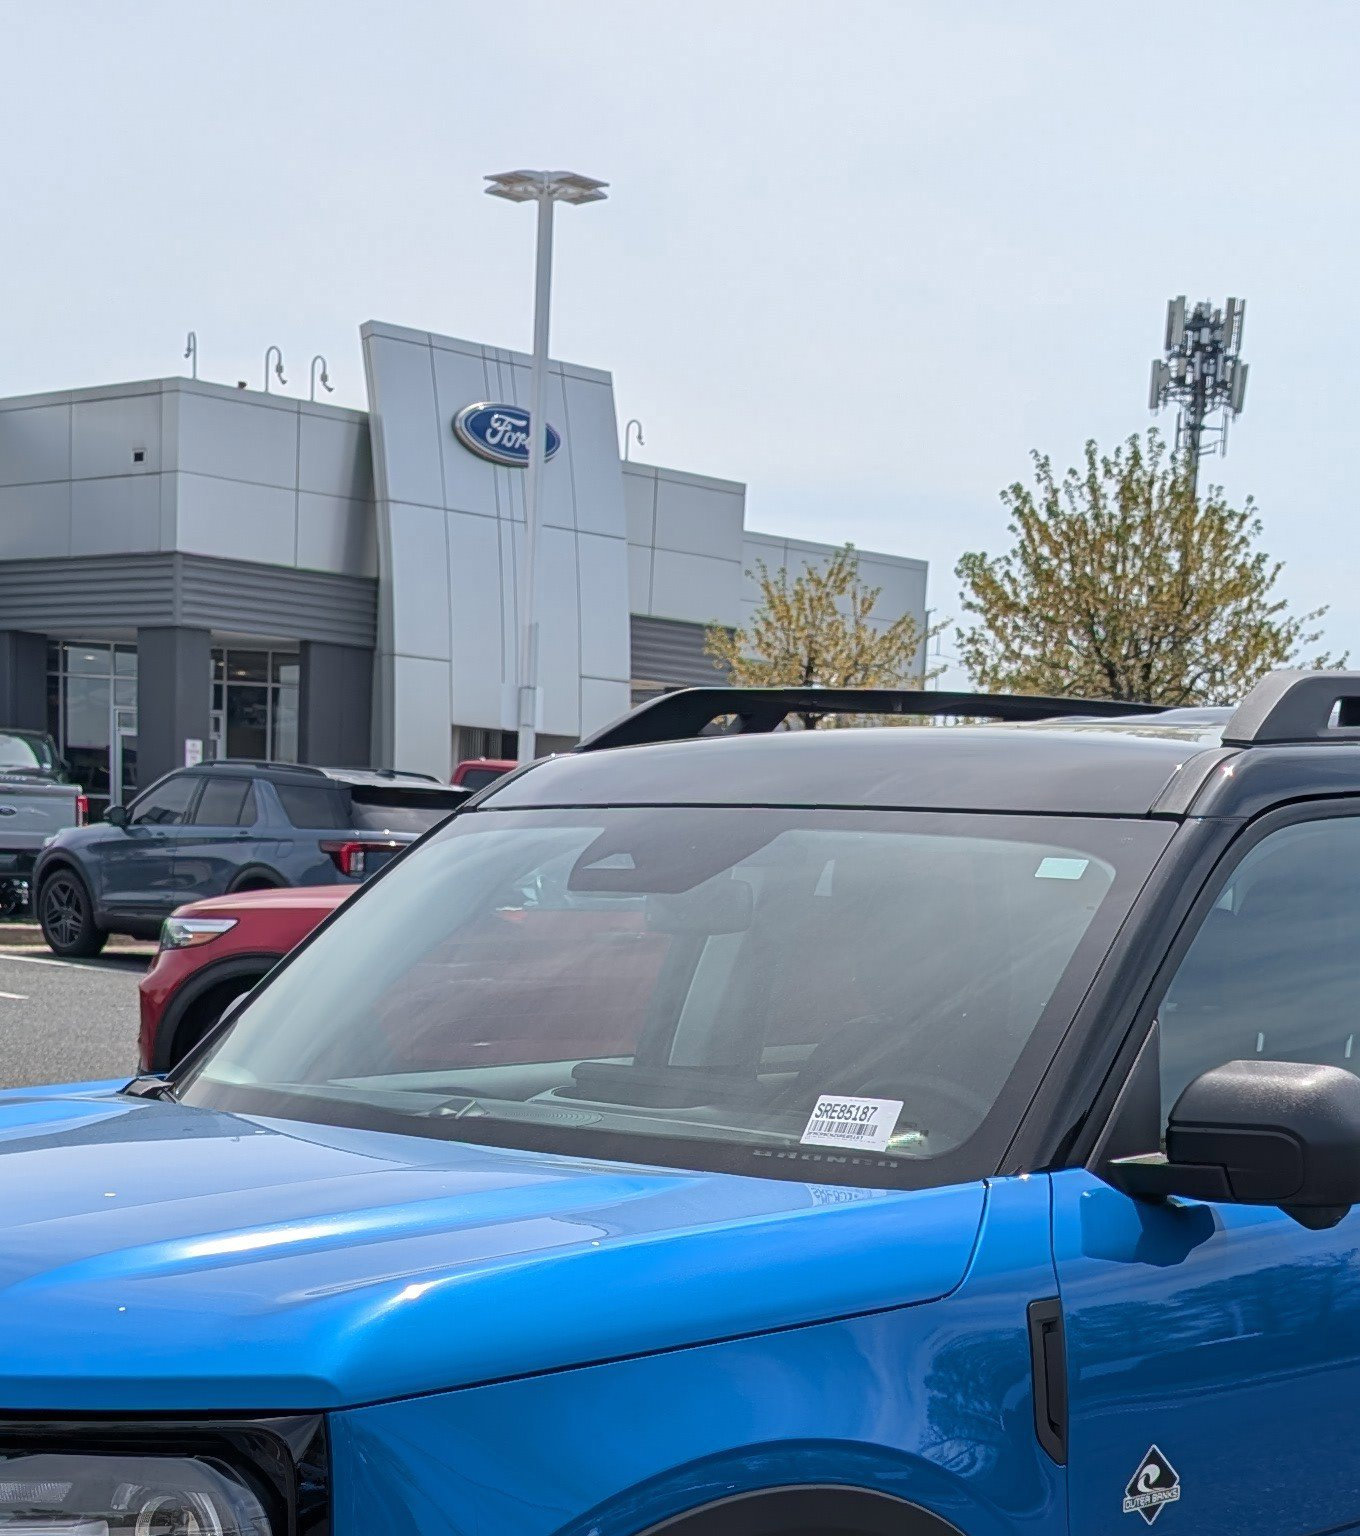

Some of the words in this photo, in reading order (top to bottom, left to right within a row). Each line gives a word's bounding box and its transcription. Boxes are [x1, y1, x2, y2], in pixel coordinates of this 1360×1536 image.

[485, 413, 531, 450] For
[814, 1102, 879, 1123] SRE85187
[1124, 1495, 1151, 1510] OUTER
[1151, 1488, 1178, 1504] BANKS
